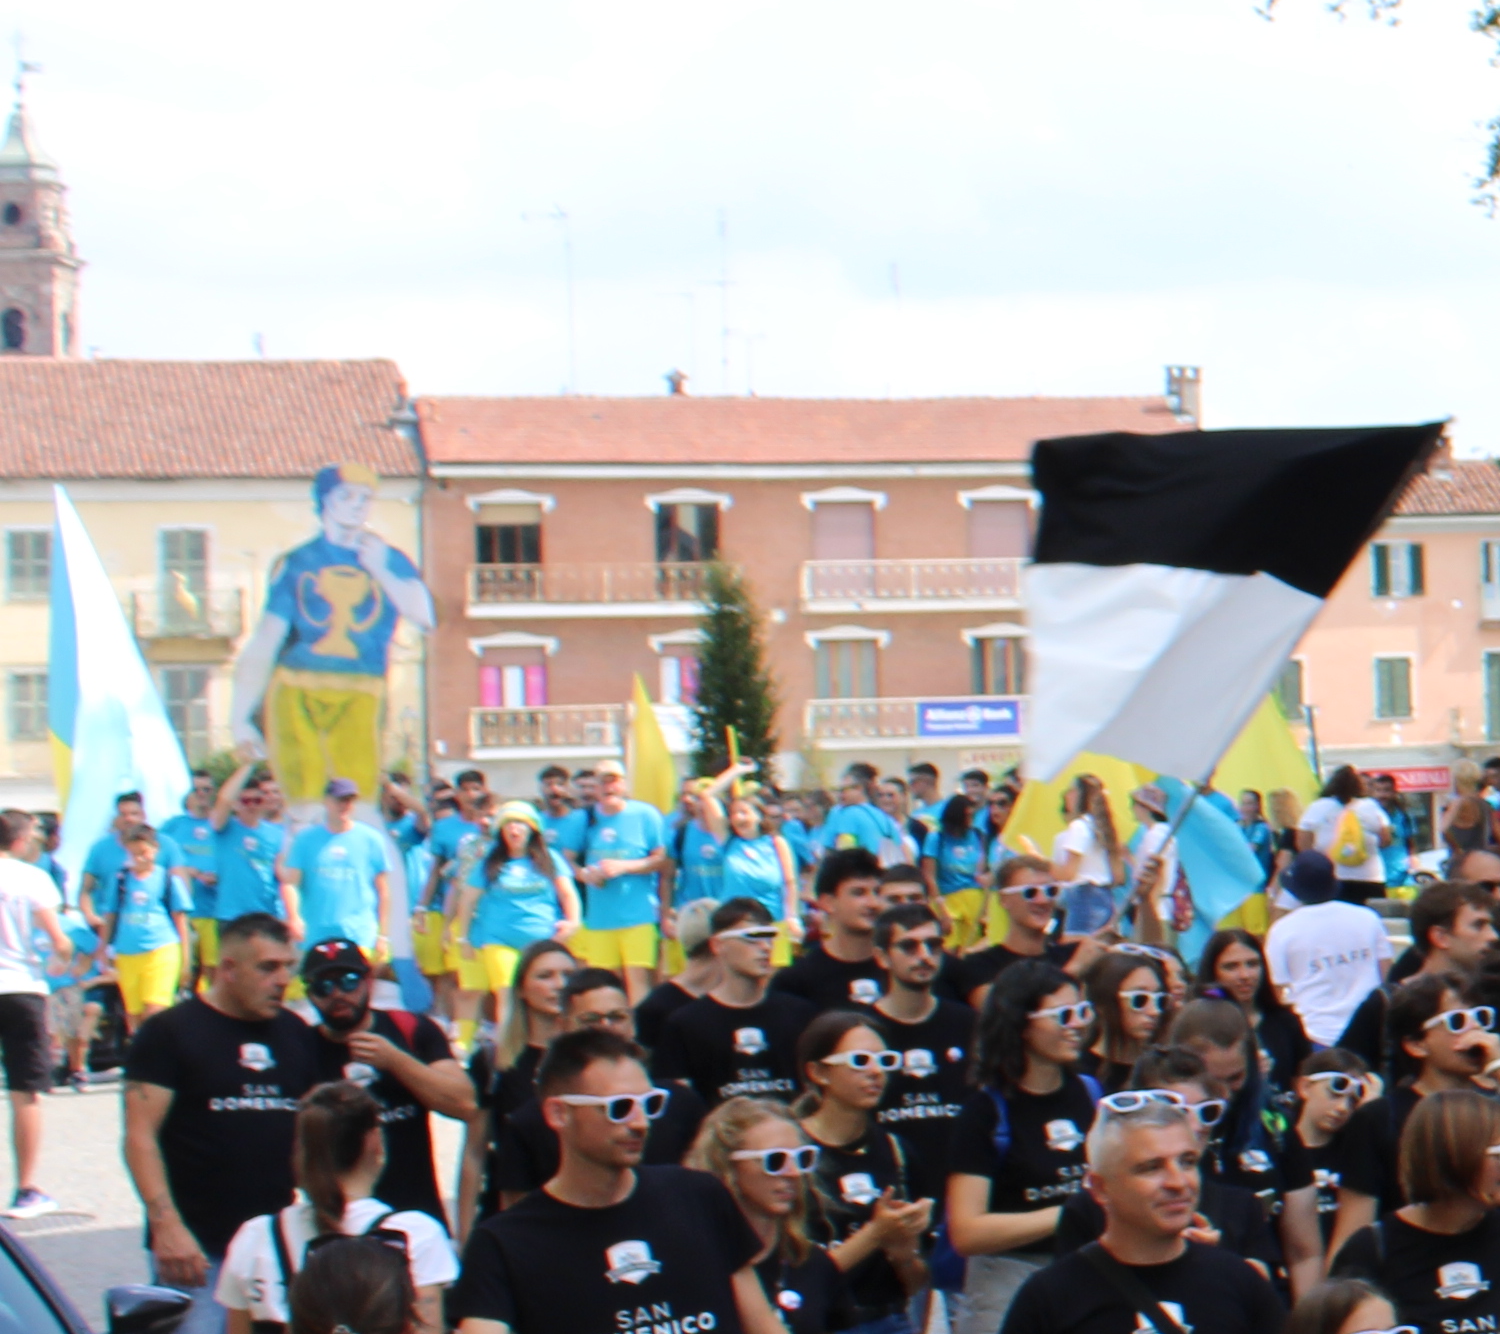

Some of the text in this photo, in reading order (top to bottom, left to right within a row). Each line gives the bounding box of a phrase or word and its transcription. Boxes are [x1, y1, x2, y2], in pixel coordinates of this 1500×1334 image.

[1308, 947, 1370, 971] STAFF
[241, 1084, 281, 1097] SAN
[902, 1093, 941, 1106] SAN
[615, 1301, 672, 1330] SAN
[1441, 1315, 1496, 1334] SAN
